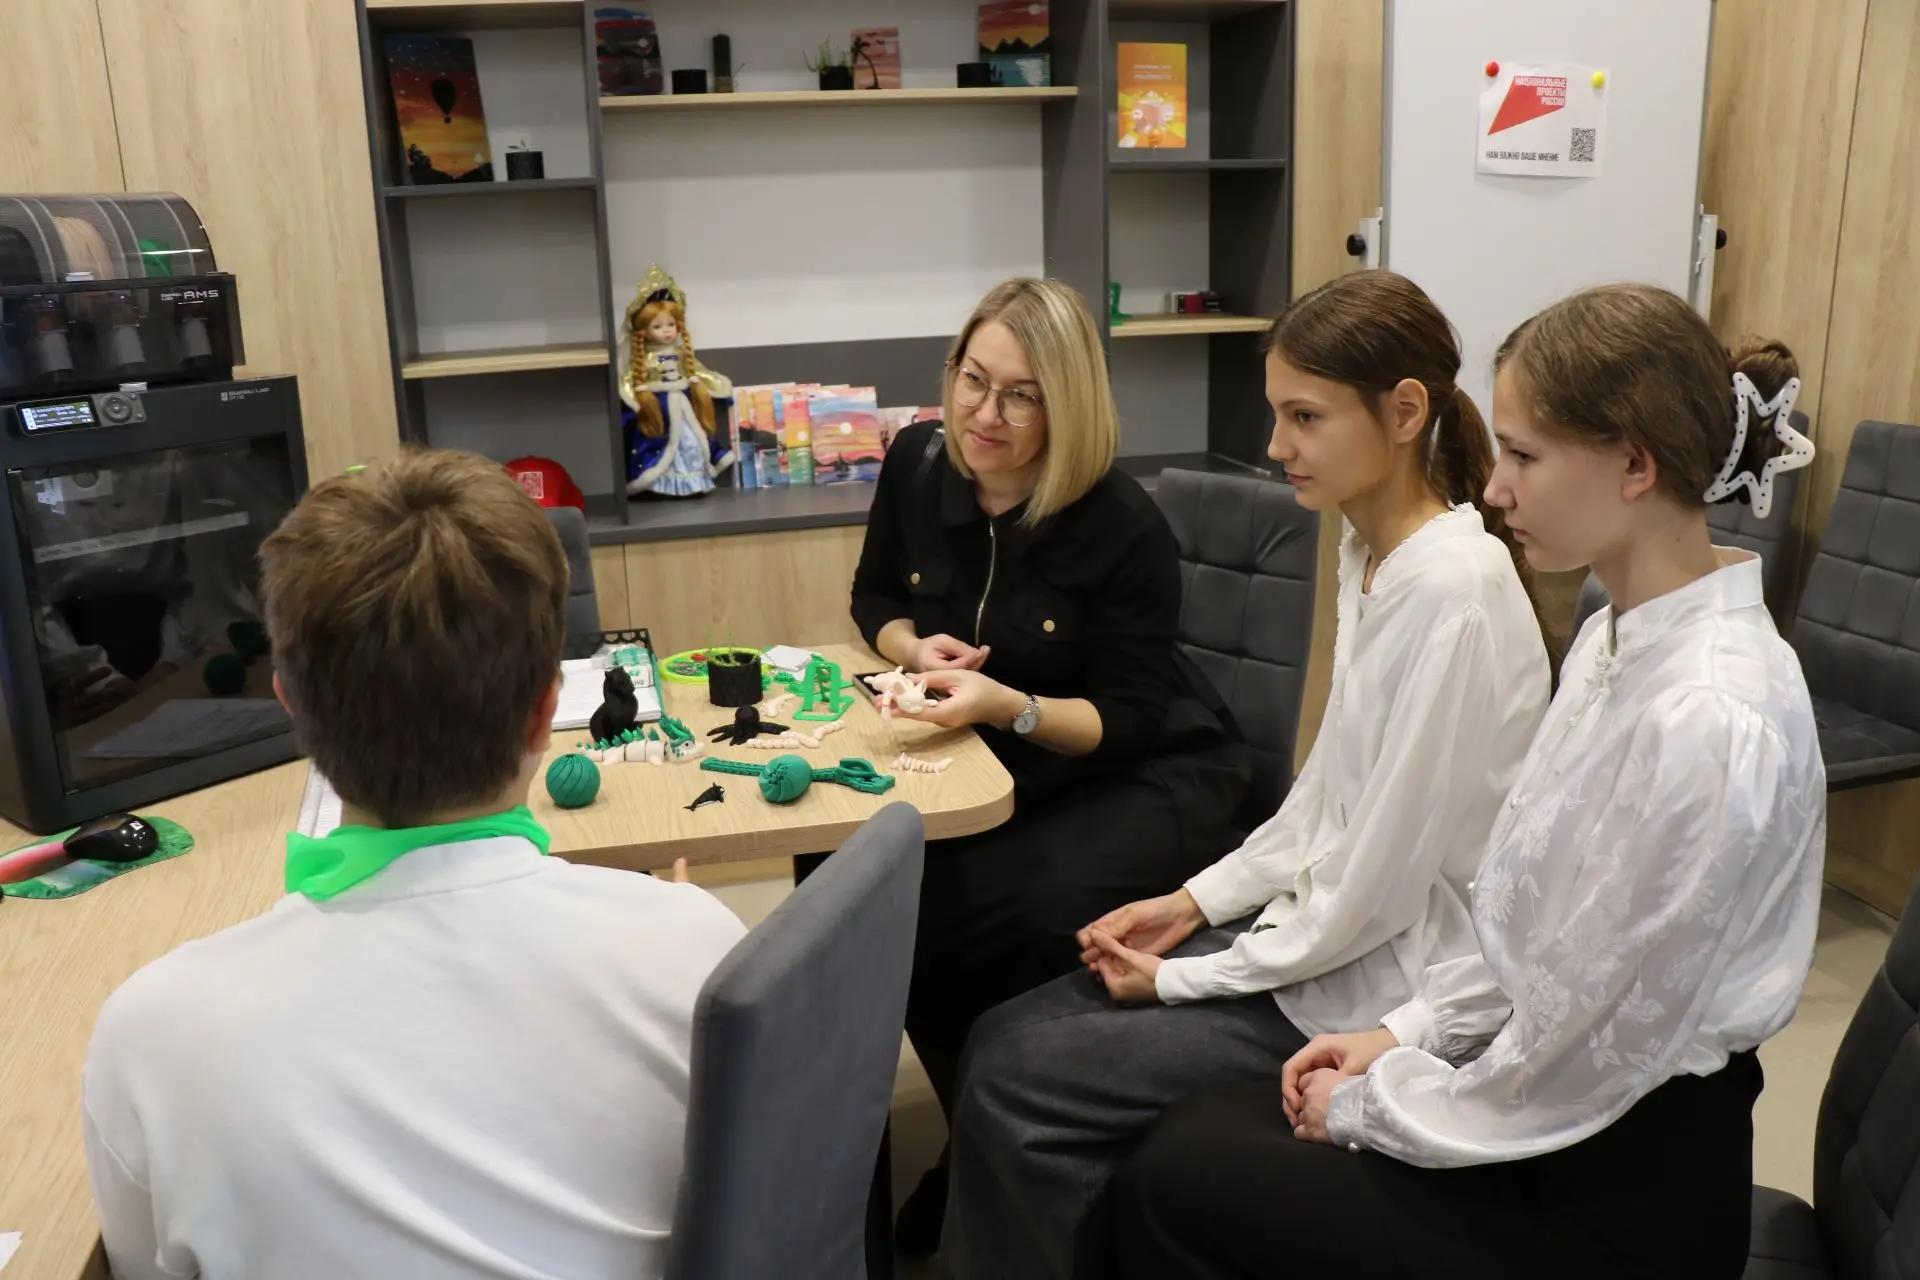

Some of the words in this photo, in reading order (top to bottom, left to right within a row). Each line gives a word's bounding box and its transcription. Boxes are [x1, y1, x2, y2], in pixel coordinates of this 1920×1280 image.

[1515, 77, 1567, 87] НАЦИОНАЛЬНЫЕ
[1536, 86, 1566, 96] ПРОЕКТЫ
[1486, 151, 1499, 159] НАМ
[1500, 151, 1520, 160] ВАЖНО
[1521, 152, 1537, 161] ВАШЕ
[1538, 152, 1560, 162] МНЕНИЕ
[183, 289, 219, 300] AMS
